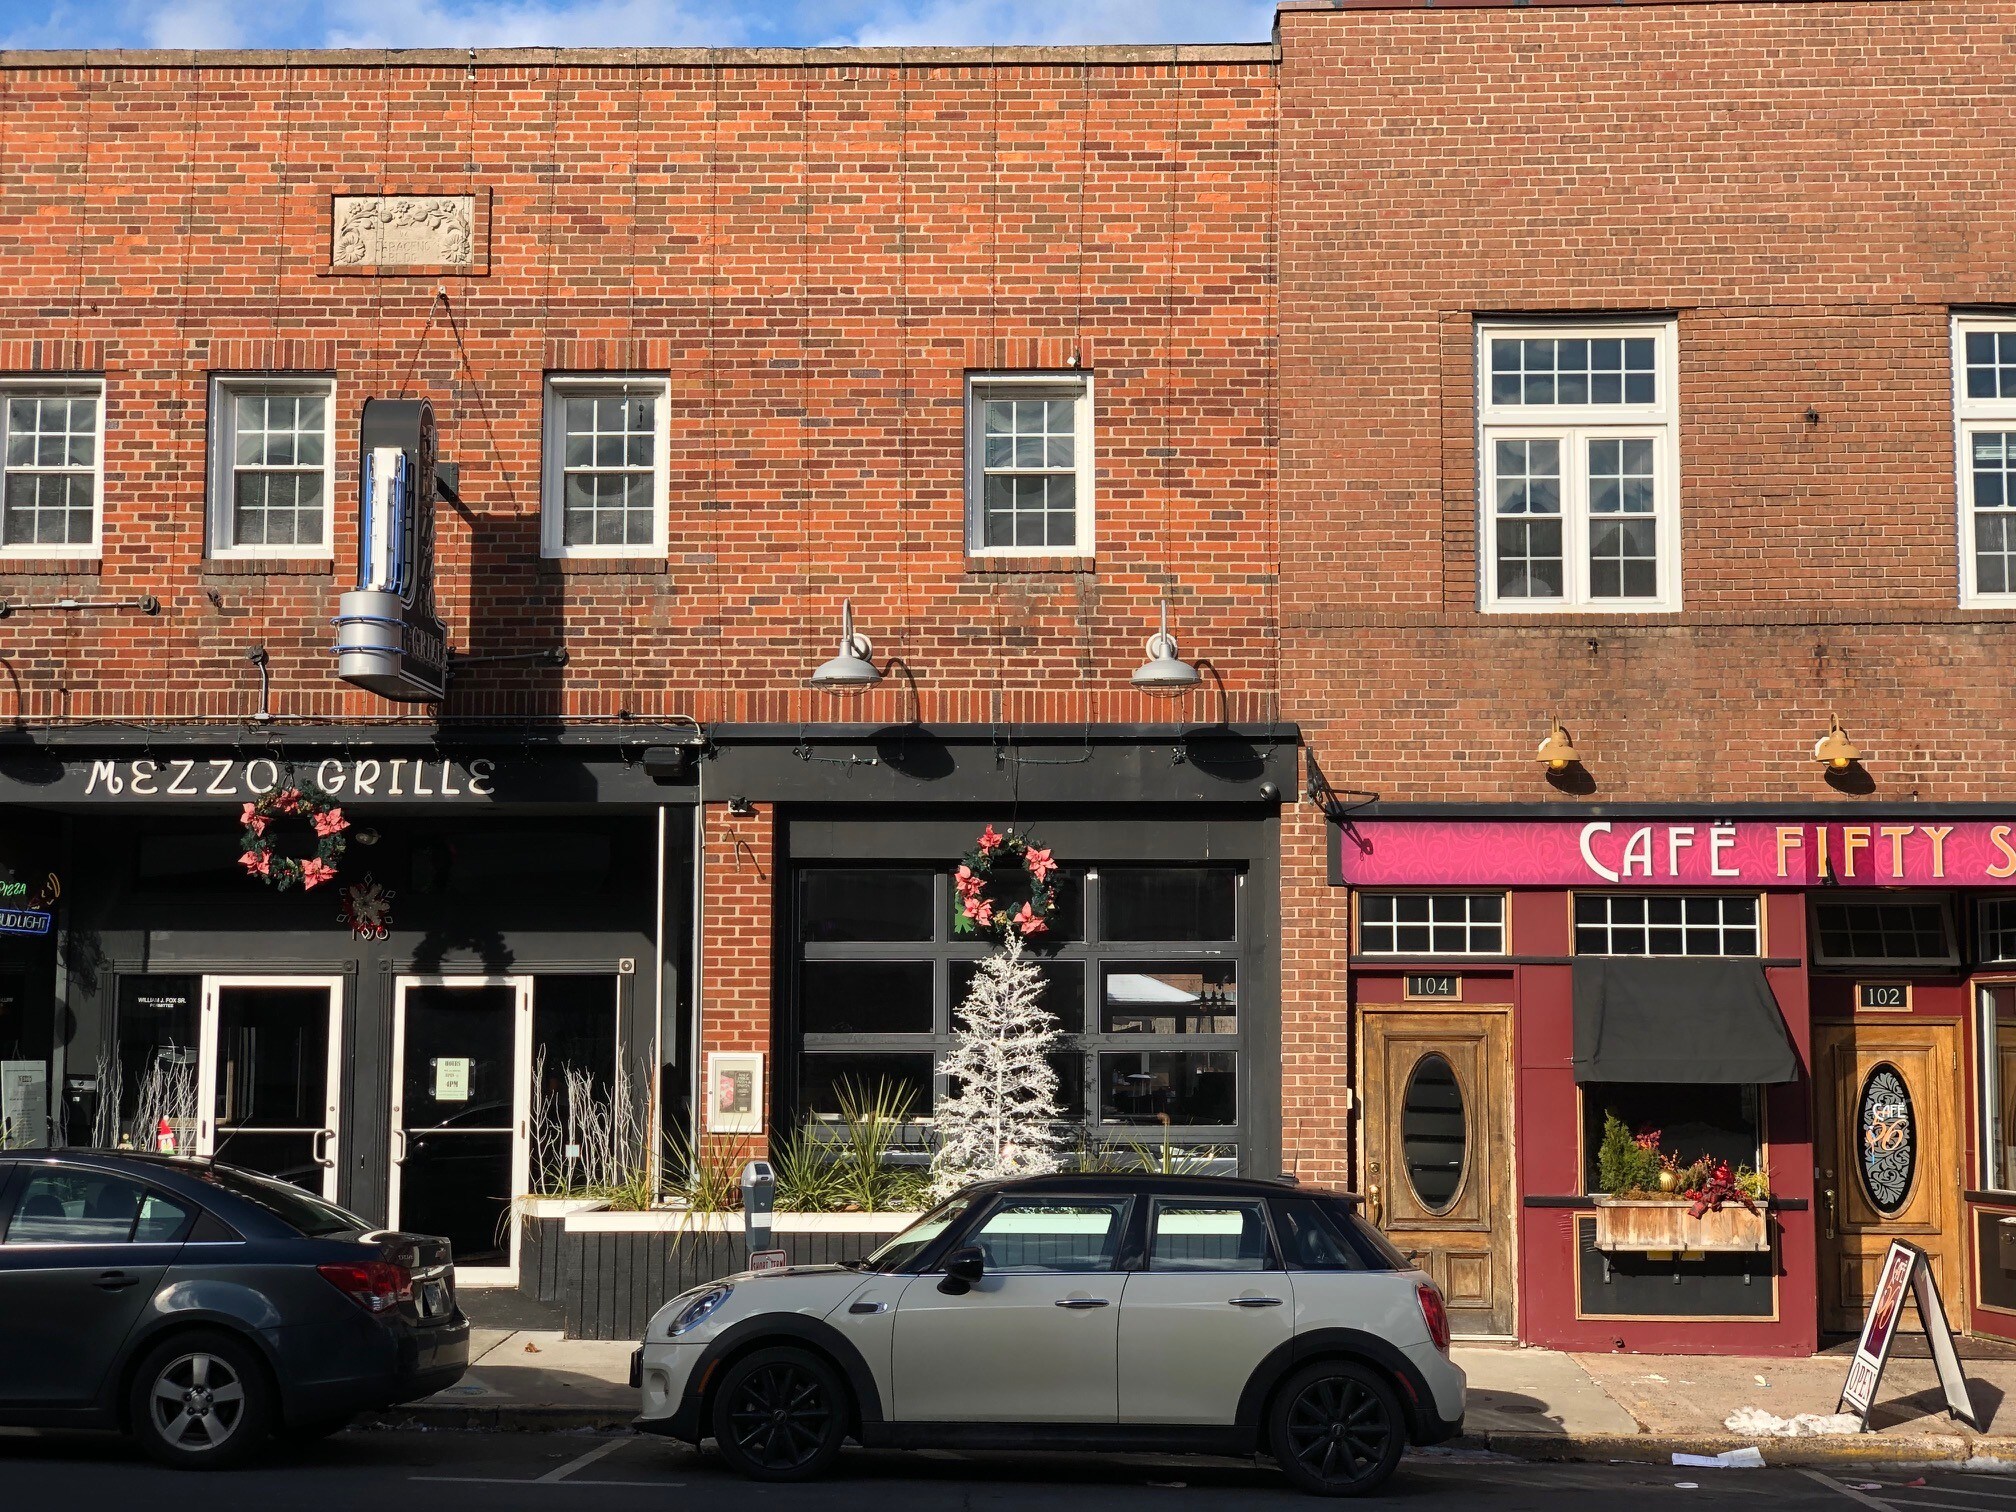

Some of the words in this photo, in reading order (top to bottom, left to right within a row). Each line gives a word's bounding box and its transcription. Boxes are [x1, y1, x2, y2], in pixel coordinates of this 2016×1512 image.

[85, 758, 279, 795] MEZZO
[317, 758, 496, 795] GRILLE
[1776, 826, 1954, 878] FIFTY
[1415, 977, 1449, 996] 104
[1868, 988, 1900, 1005] 102
[1865, 1111, 1908, 1151] 56
[1848, 1361, 1877, 1402] OPEN
